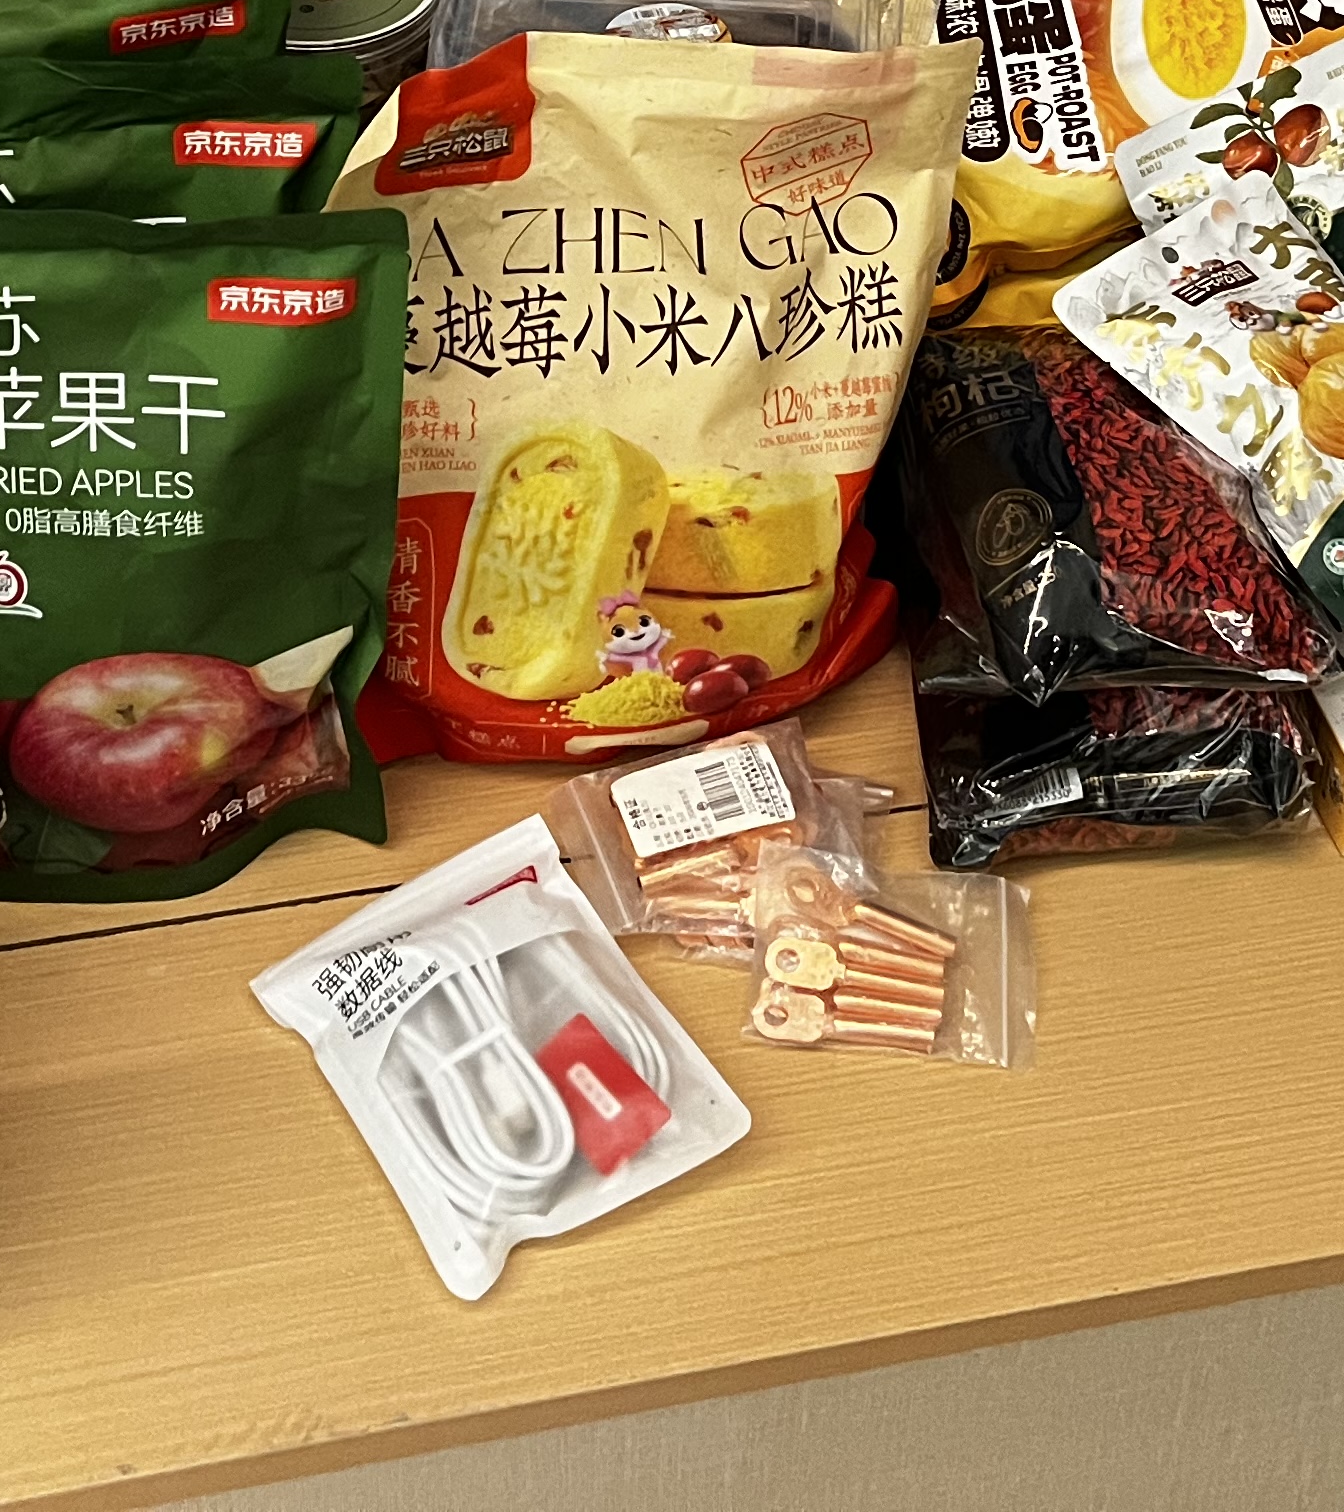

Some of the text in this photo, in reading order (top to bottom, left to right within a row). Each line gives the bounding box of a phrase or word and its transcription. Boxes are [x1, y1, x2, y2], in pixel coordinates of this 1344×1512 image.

[119, 5, 237, 44] 京东京造
[1007, 61, 1042, 97] EGG
[1044, 52, 1102, 164] POT-ROAST
[184, 129, 304, 159] 京东京造
[399, 124, 510, 170] 三只松鼠
[752, 133, 866, 186] 中式糕点
[786, 170, 849, 204] 好味道
[501, 207, 706, 276] ZHEN
[739, 193, 899, 271] GAO
[219, 284, 346, 317] 京东京造
[774, 385, 813, 426] 12%
[921, 370, 1021, 434] 枸杞
[419, 460, 446, 470] HAO
[449, 460, 477, 470] LIAO
[421, 447, 455, 458] XUAN
[71, 468, 195, 501] APPLES
[4, 506, 205, 539] 0脂高膳食纤维
[334, 947, 405, 1023] 数据线
[368, 974, 408, 1013] CABLE
